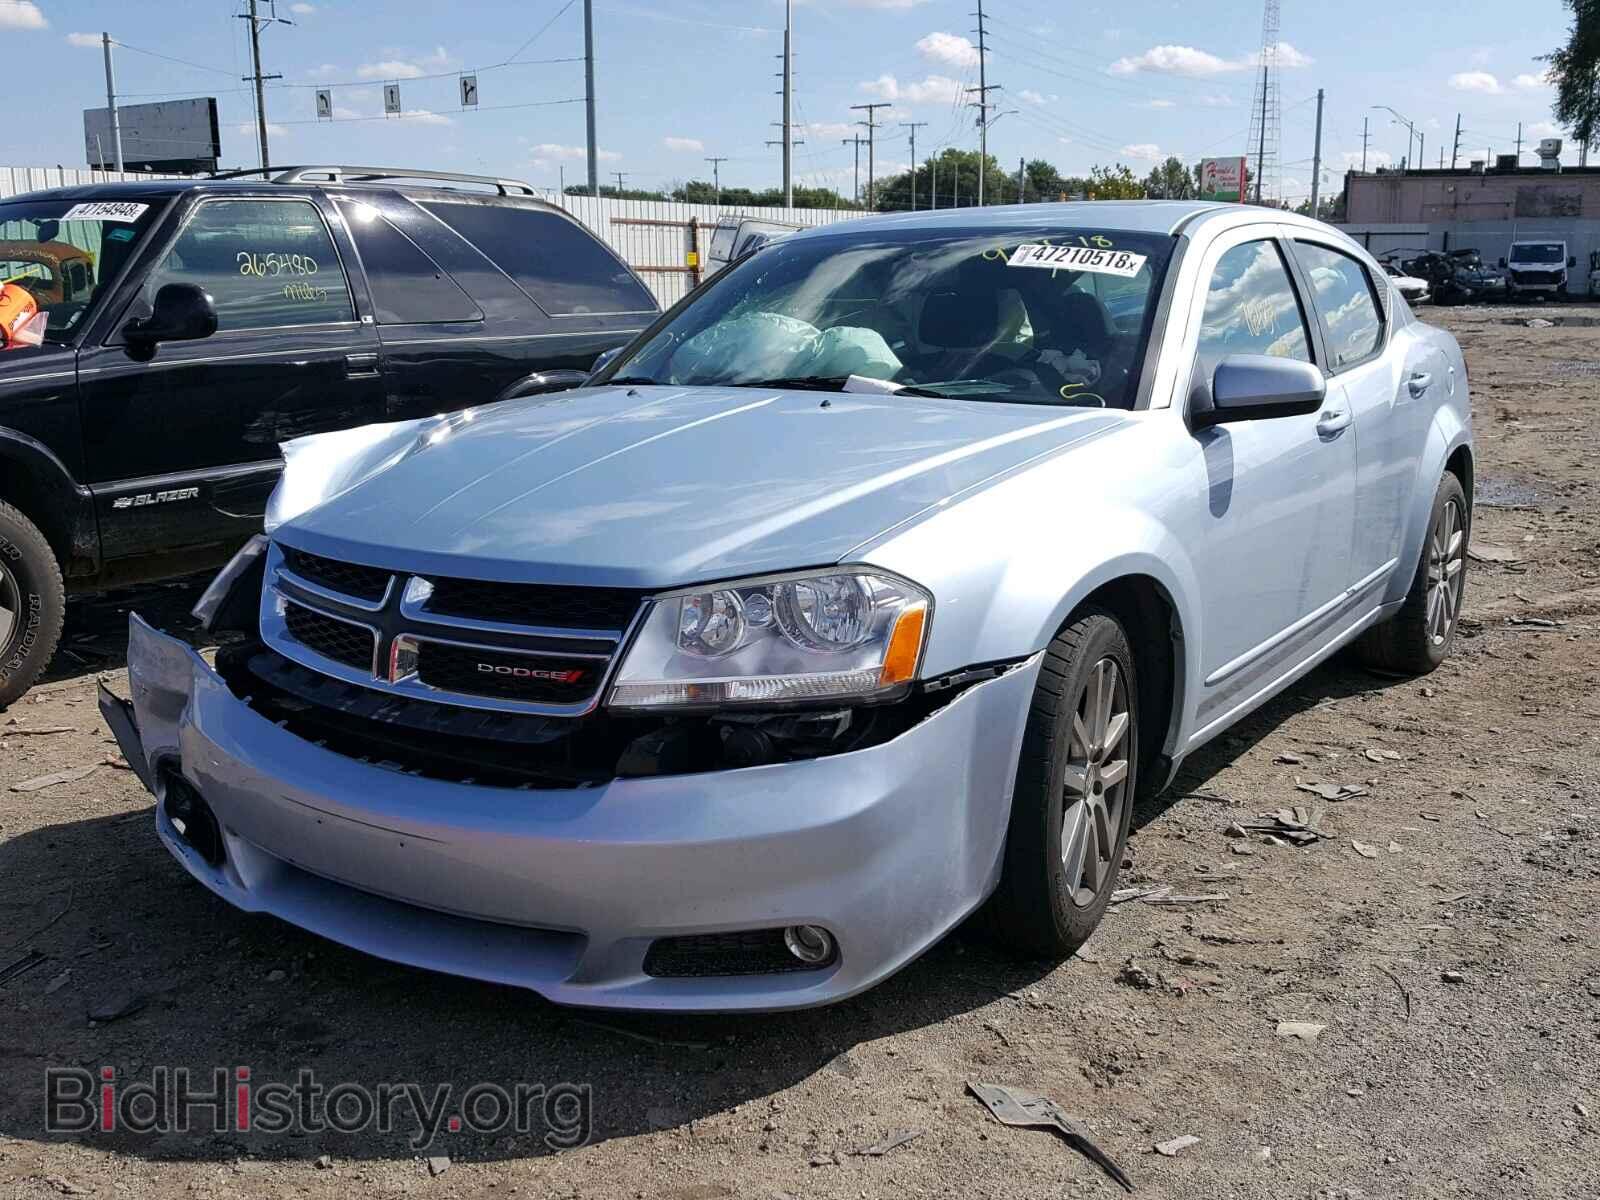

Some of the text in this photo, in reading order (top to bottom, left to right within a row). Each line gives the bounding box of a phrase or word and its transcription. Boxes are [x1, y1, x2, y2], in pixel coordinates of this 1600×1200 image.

[236, 251, 318, 278] 265480
[133, 487, 199, 507] BLAZER
[477, 663, 567, 682] DODGE
